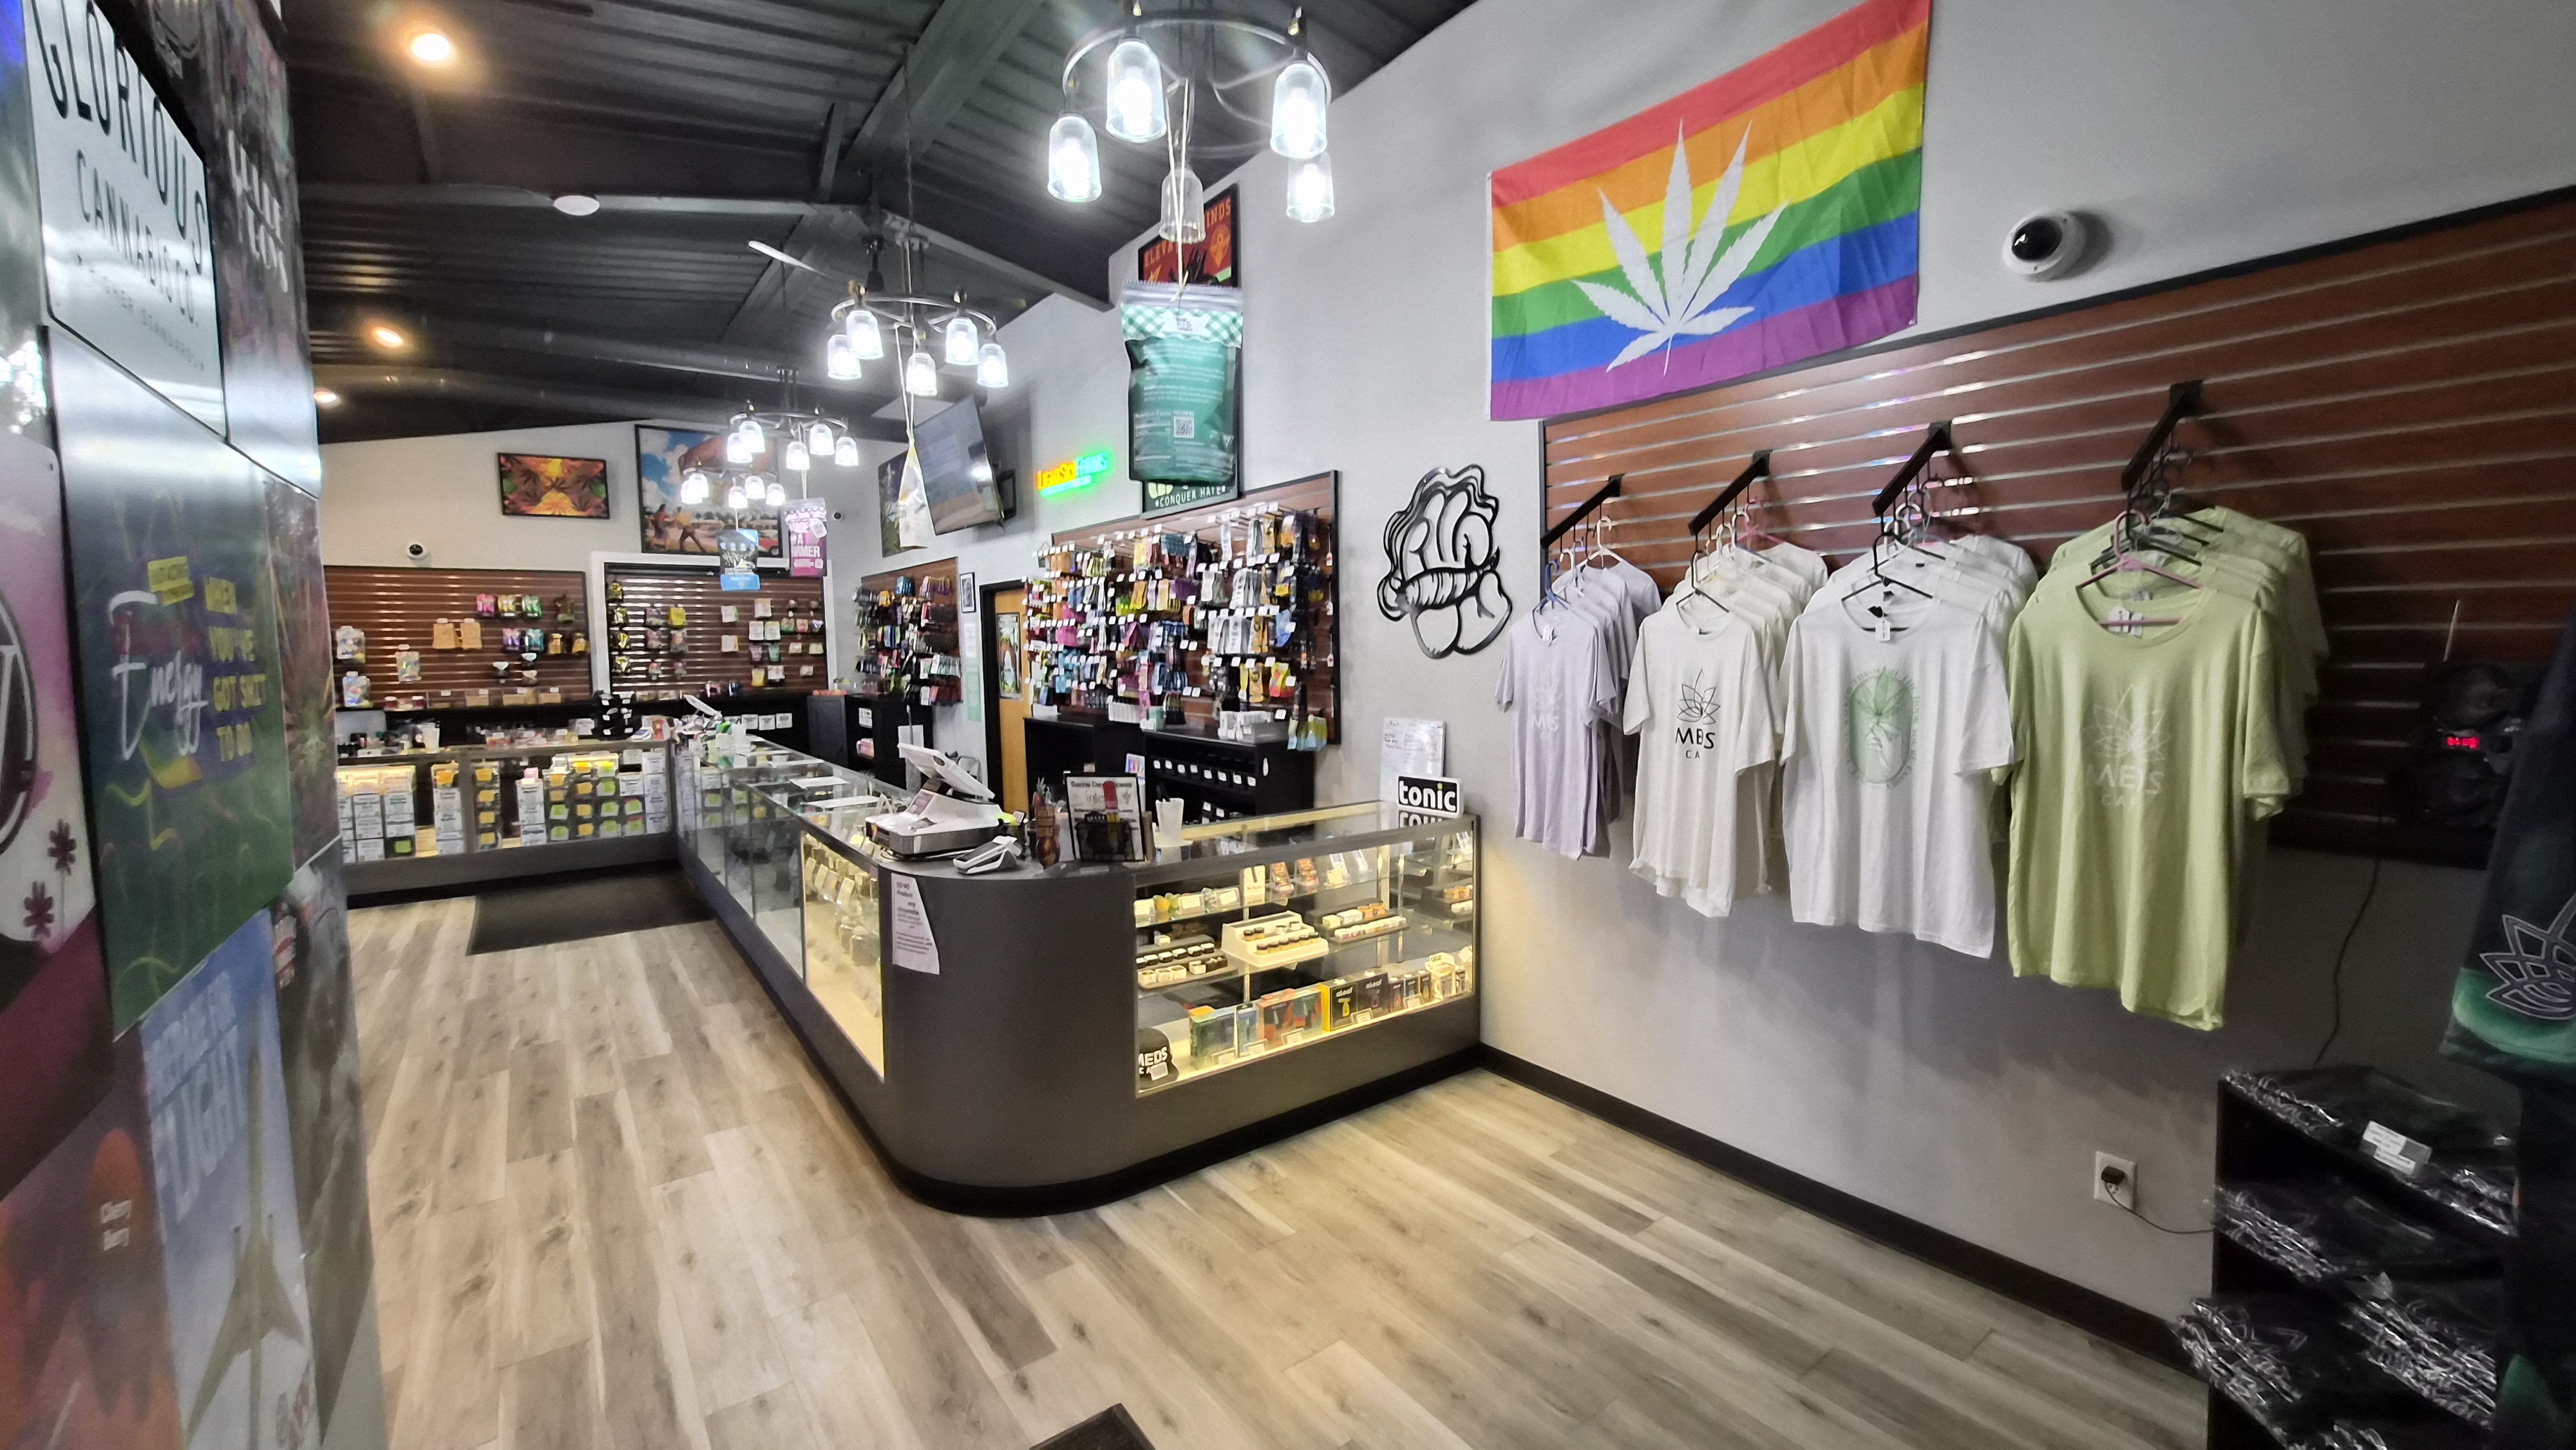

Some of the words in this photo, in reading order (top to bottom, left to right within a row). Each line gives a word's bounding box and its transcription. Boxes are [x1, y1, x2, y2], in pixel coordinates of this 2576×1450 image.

[32, 0, 205, 276] GLORIOUS
[77, 149, 173, 303] CANNABIS
[1204, 198, 1231, 228] INDS
[1160, 489, 1196, 507] CONQUER
[1399, 780, 1456, 811] tonic
